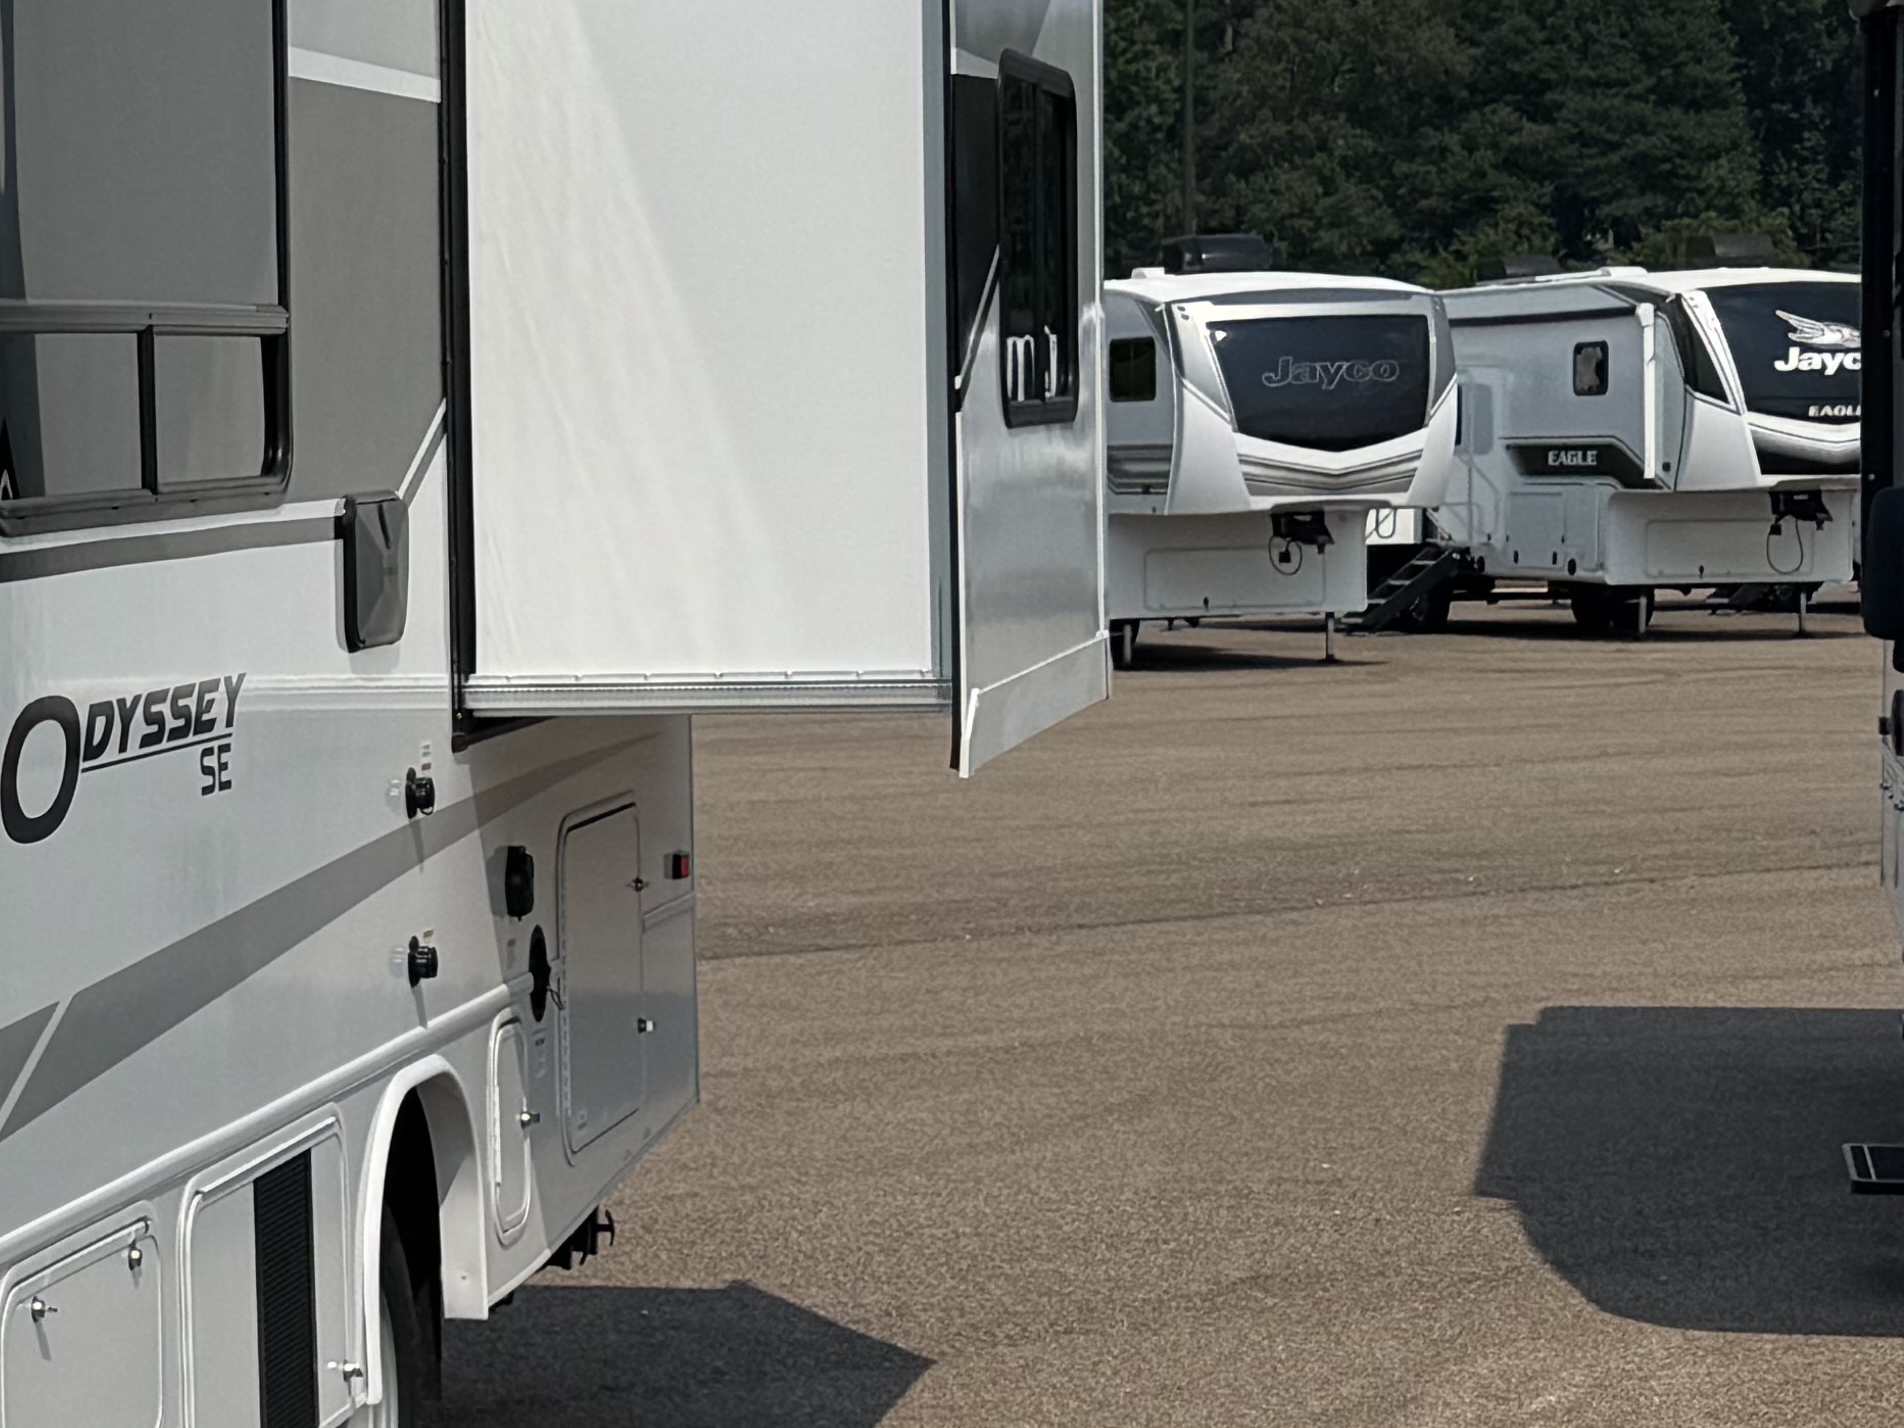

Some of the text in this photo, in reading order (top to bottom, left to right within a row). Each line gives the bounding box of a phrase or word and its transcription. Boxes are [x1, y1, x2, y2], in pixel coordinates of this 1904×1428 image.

[1262, 356, 1399, 390] Jayco
[1774, 346, 1862, 375] Jayc
[1548, 449, 1597, 465] EAGLE
[0, 672, 247, 845] ODYSSEY
[199, 743, 233, 796] SE
